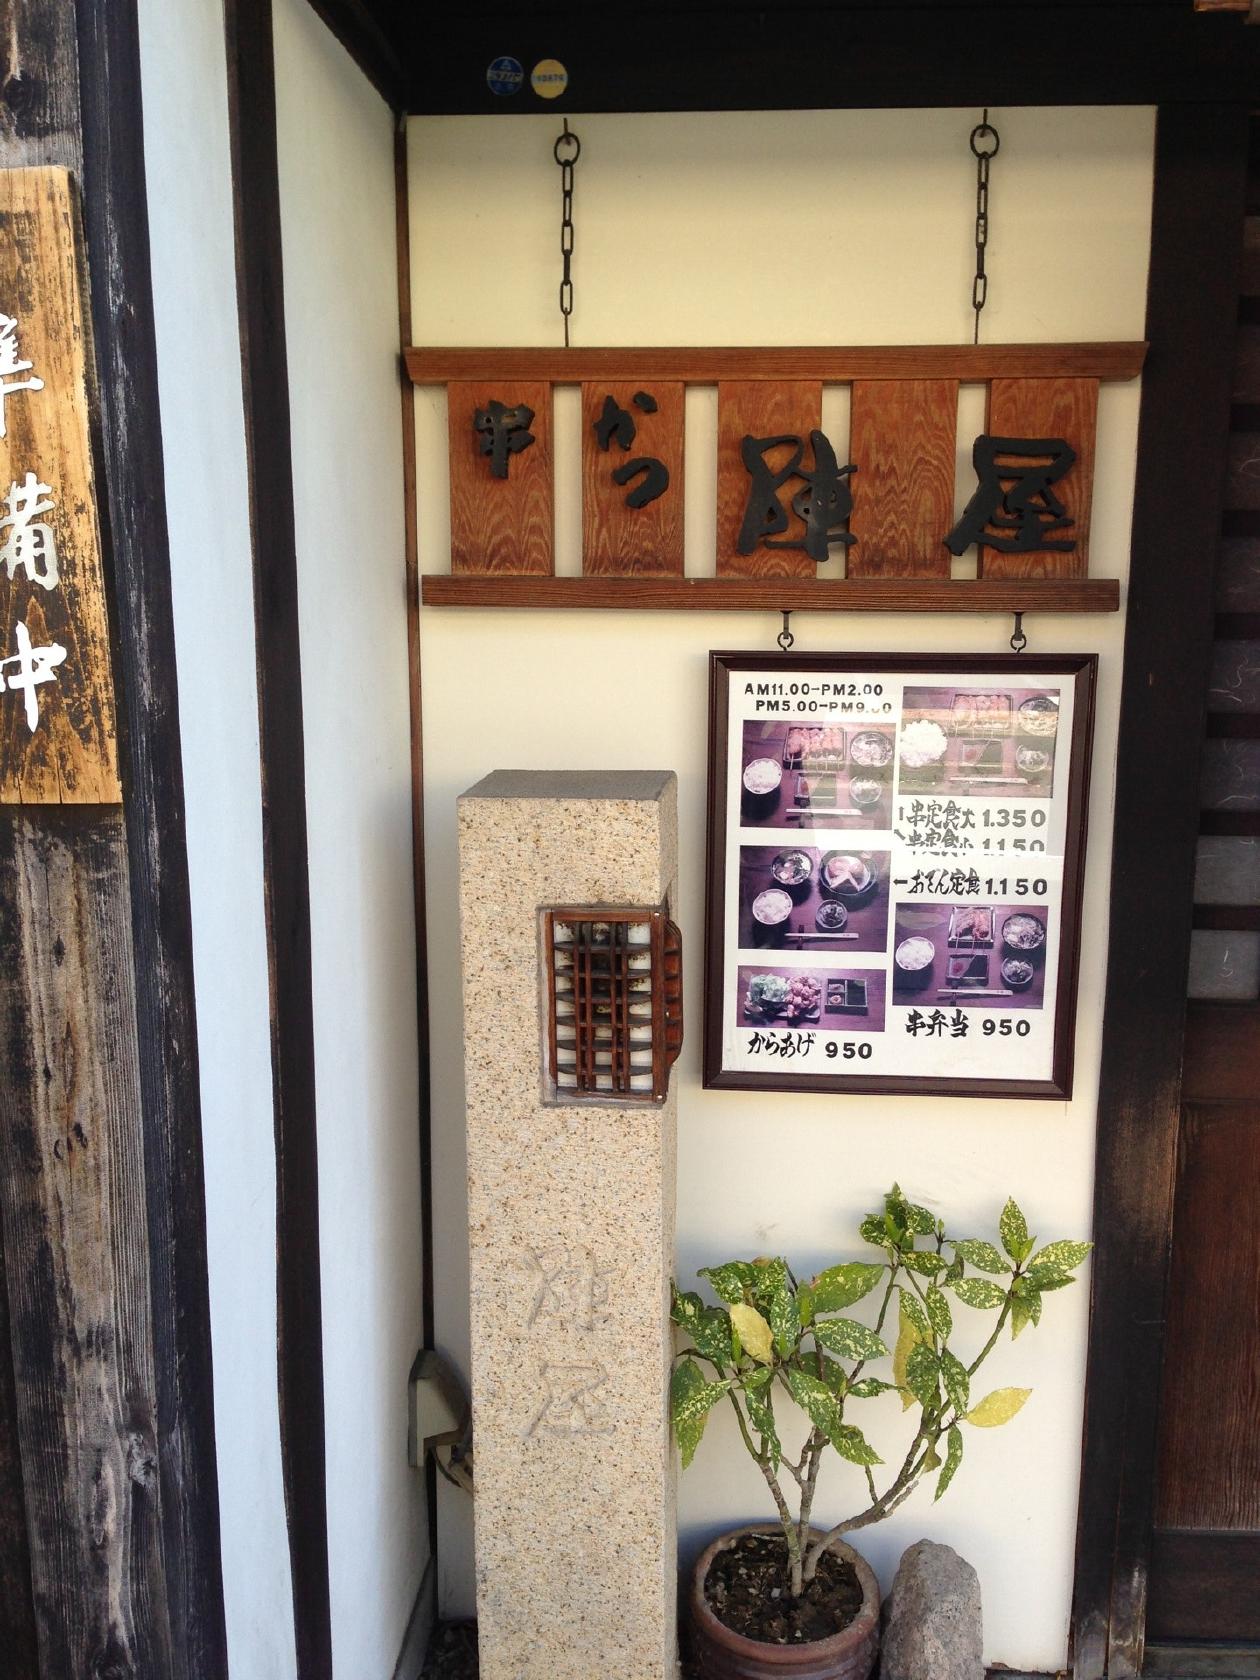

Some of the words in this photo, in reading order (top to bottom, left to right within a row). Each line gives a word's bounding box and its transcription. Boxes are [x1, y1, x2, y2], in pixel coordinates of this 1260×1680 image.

[906, 799, 976, 831] 串定食大
[982, 809, 1047, 828] 1.350
[985, 878, 1048, 896] 1.150
[904, 1008, 969, 1038] 串弁当
[982, 1018, 1031, 1037] 950
[747, 1031, 817, 1058] からあげ
[825, 1042, 873, 1059] 950
